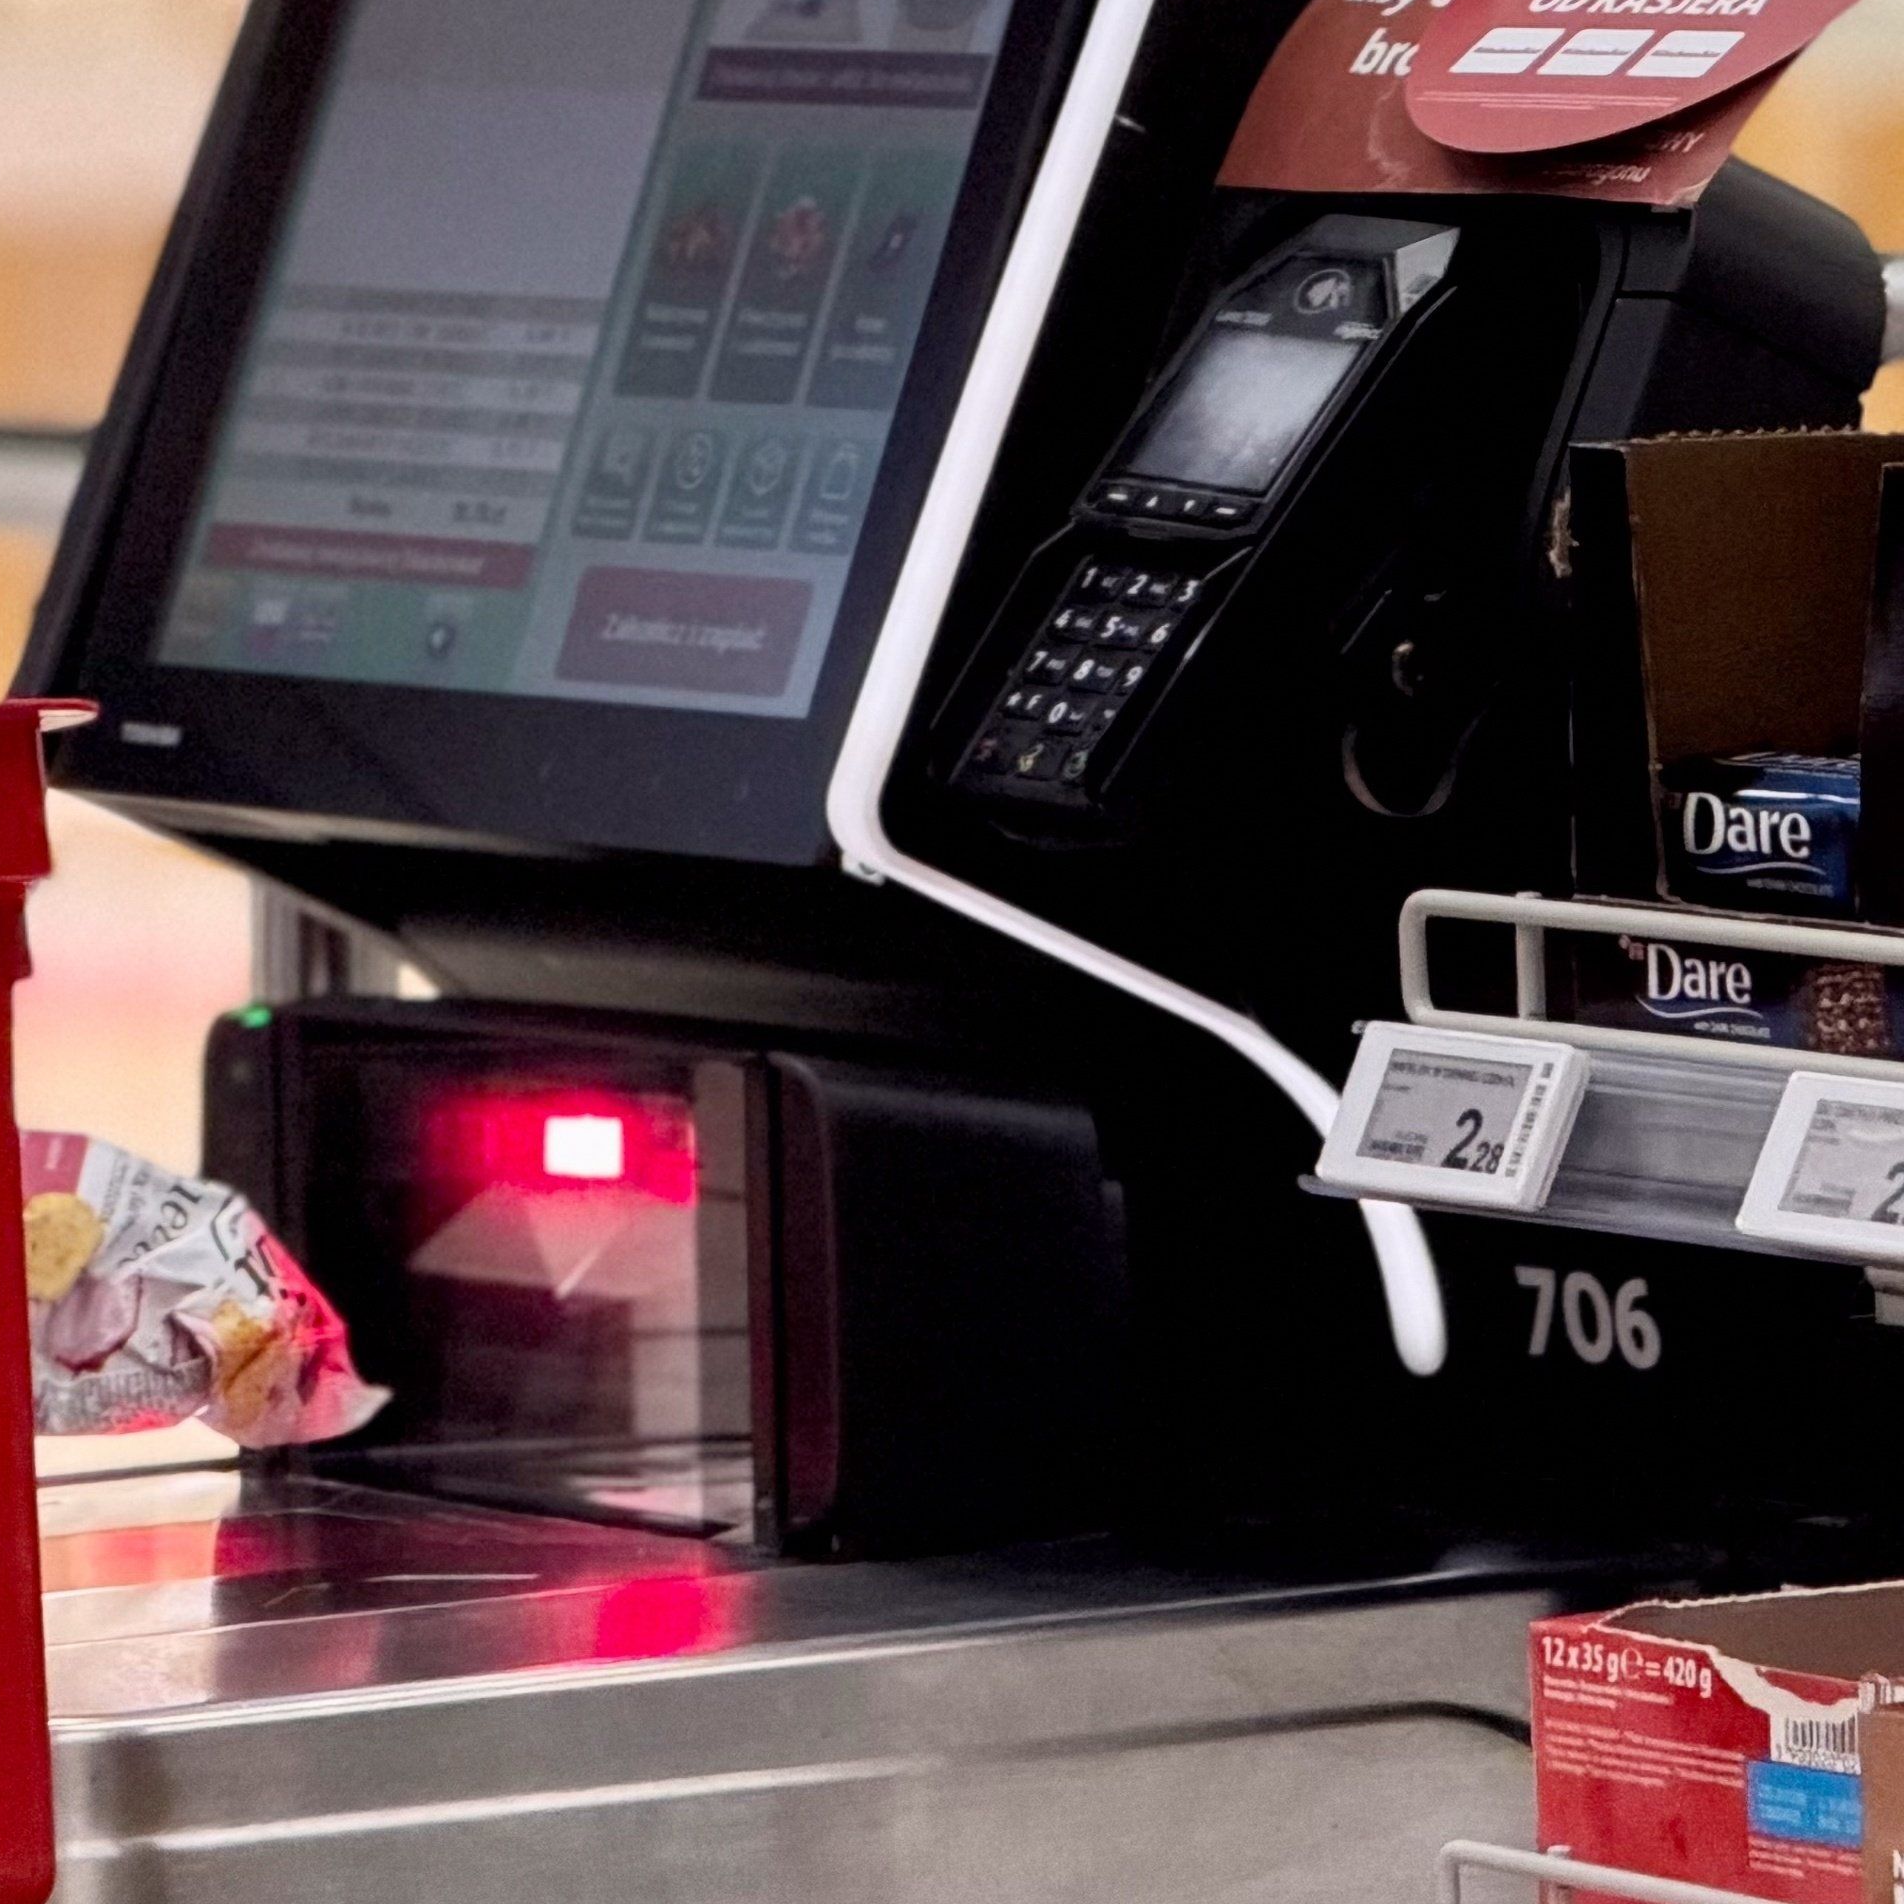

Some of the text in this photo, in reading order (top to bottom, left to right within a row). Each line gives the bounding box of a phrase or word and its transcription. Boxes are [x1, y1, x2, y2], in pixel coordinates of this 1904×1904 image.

[1081, 566, 1200, 602] 1 2 3
[1100, 615, 1123, 638] 5
[1150, 622, 1171, 643] 6
[1026, 650, 1143, 688] 7 8 9
[1683, 791, 1811, 859] Dare
[1647, 943, 1752, 1004] Dare
[1515, 1264, 1662, 1370] 706
